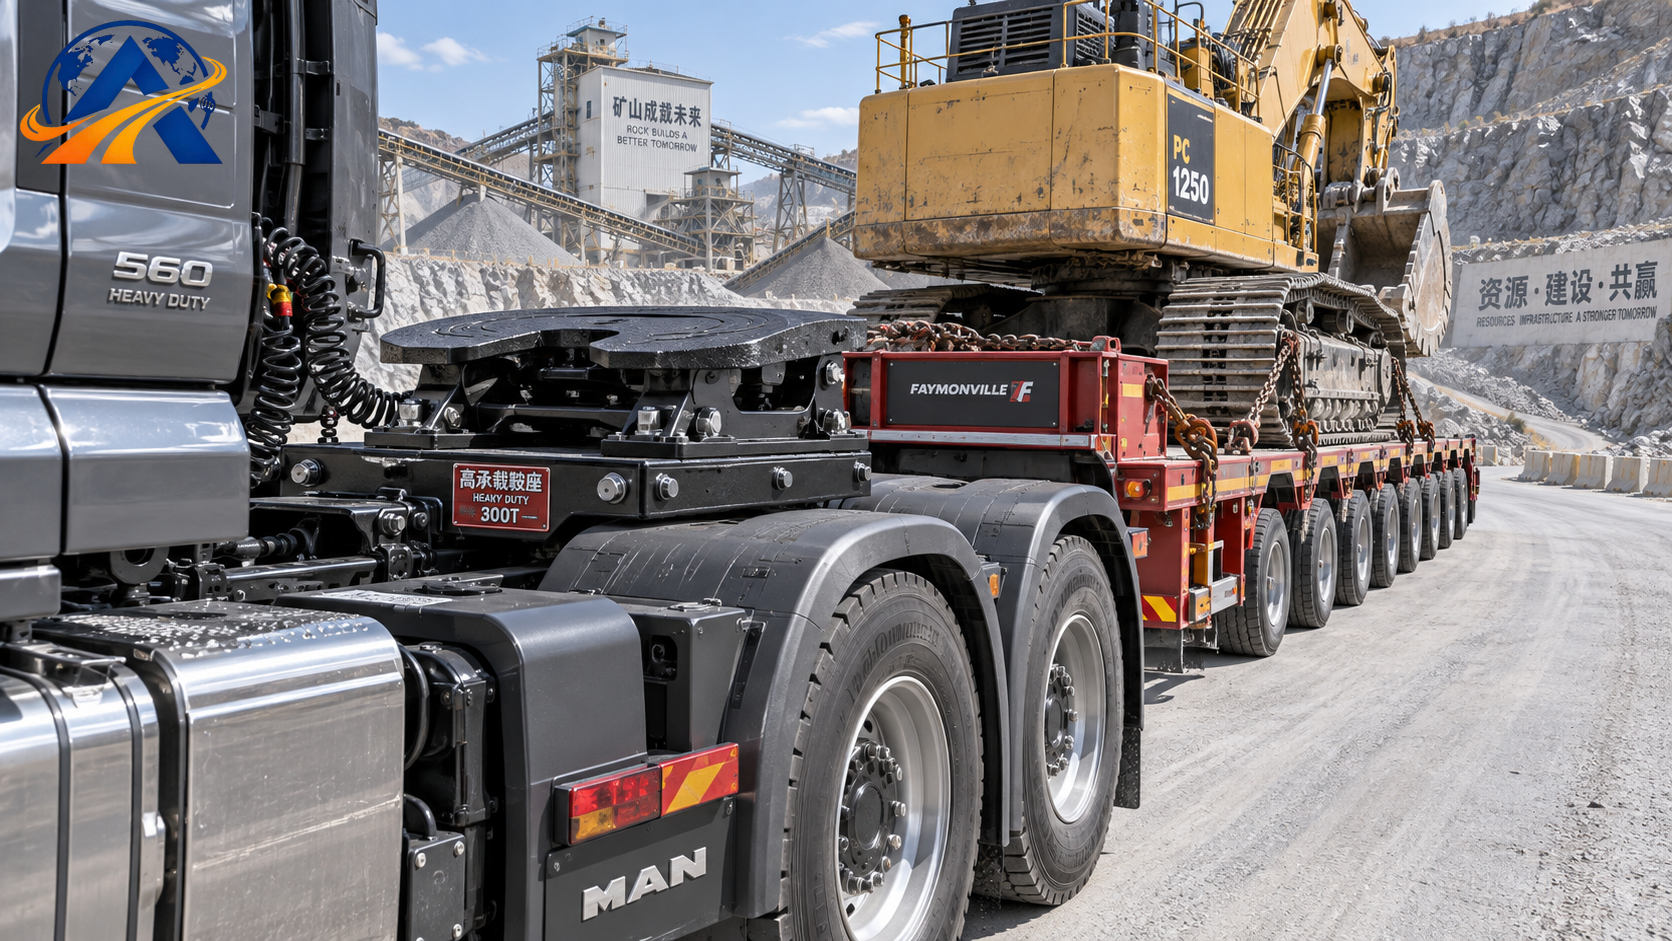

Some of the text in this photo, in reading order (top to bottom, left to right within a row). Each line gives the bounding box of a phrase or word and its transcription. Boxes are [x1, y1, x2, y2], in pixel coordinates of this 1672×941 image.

[626, 125, 688, 140] ROCK BUILDS A
[617, 135, 698, 153] BETTER TOMORROW
[1173, 134, 1190, 164] PC
[1172, 165, 1209, 205] 1250
[113, 251, 213, 287] 560
[108, 288, 211, 309] HEAVY DUTY
[1476, 314, 1516, 328] RESOURCES
[1575, 311, 1582, 323] A
[1582, 308, 1617, 322] STRONGER
[1617, 305, 1658, 321] TOMORROW
[909, 383, 1009, 396] FAYMONVILLE
[504, 494, 530, 505] DUTY
[480, 506, 520, 524] 300T
[582, 846, 707, 921] MAN
